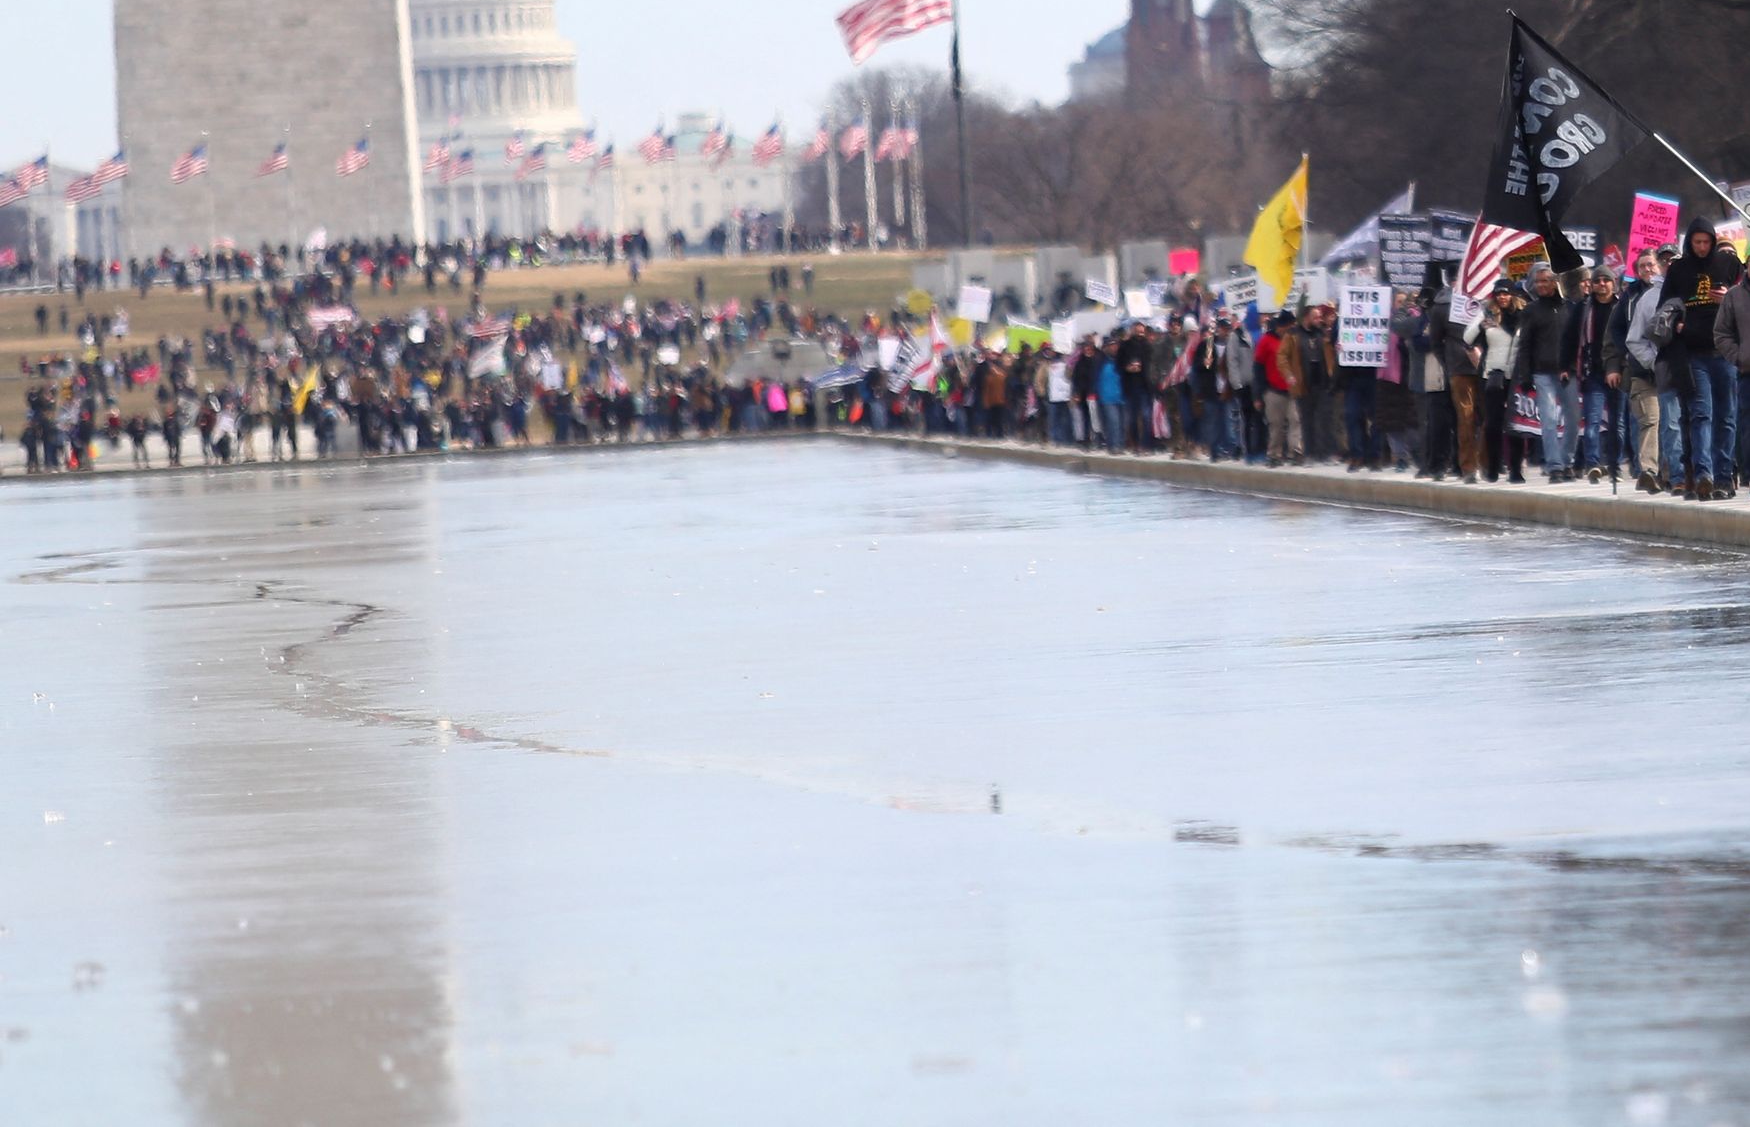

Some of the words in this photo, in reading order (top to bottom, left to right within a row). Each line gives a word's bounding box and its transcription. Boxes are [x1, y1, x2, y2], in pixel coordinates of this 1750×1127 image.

[1348, 291, 1379, 303] THIS
[1350, 304, 1363, 315] IS
[1373, 304, 1380, 314] A
[1343, 318, 1389, 330] HUMAN
[1343, 332, 1389, 344] RIGHTS
